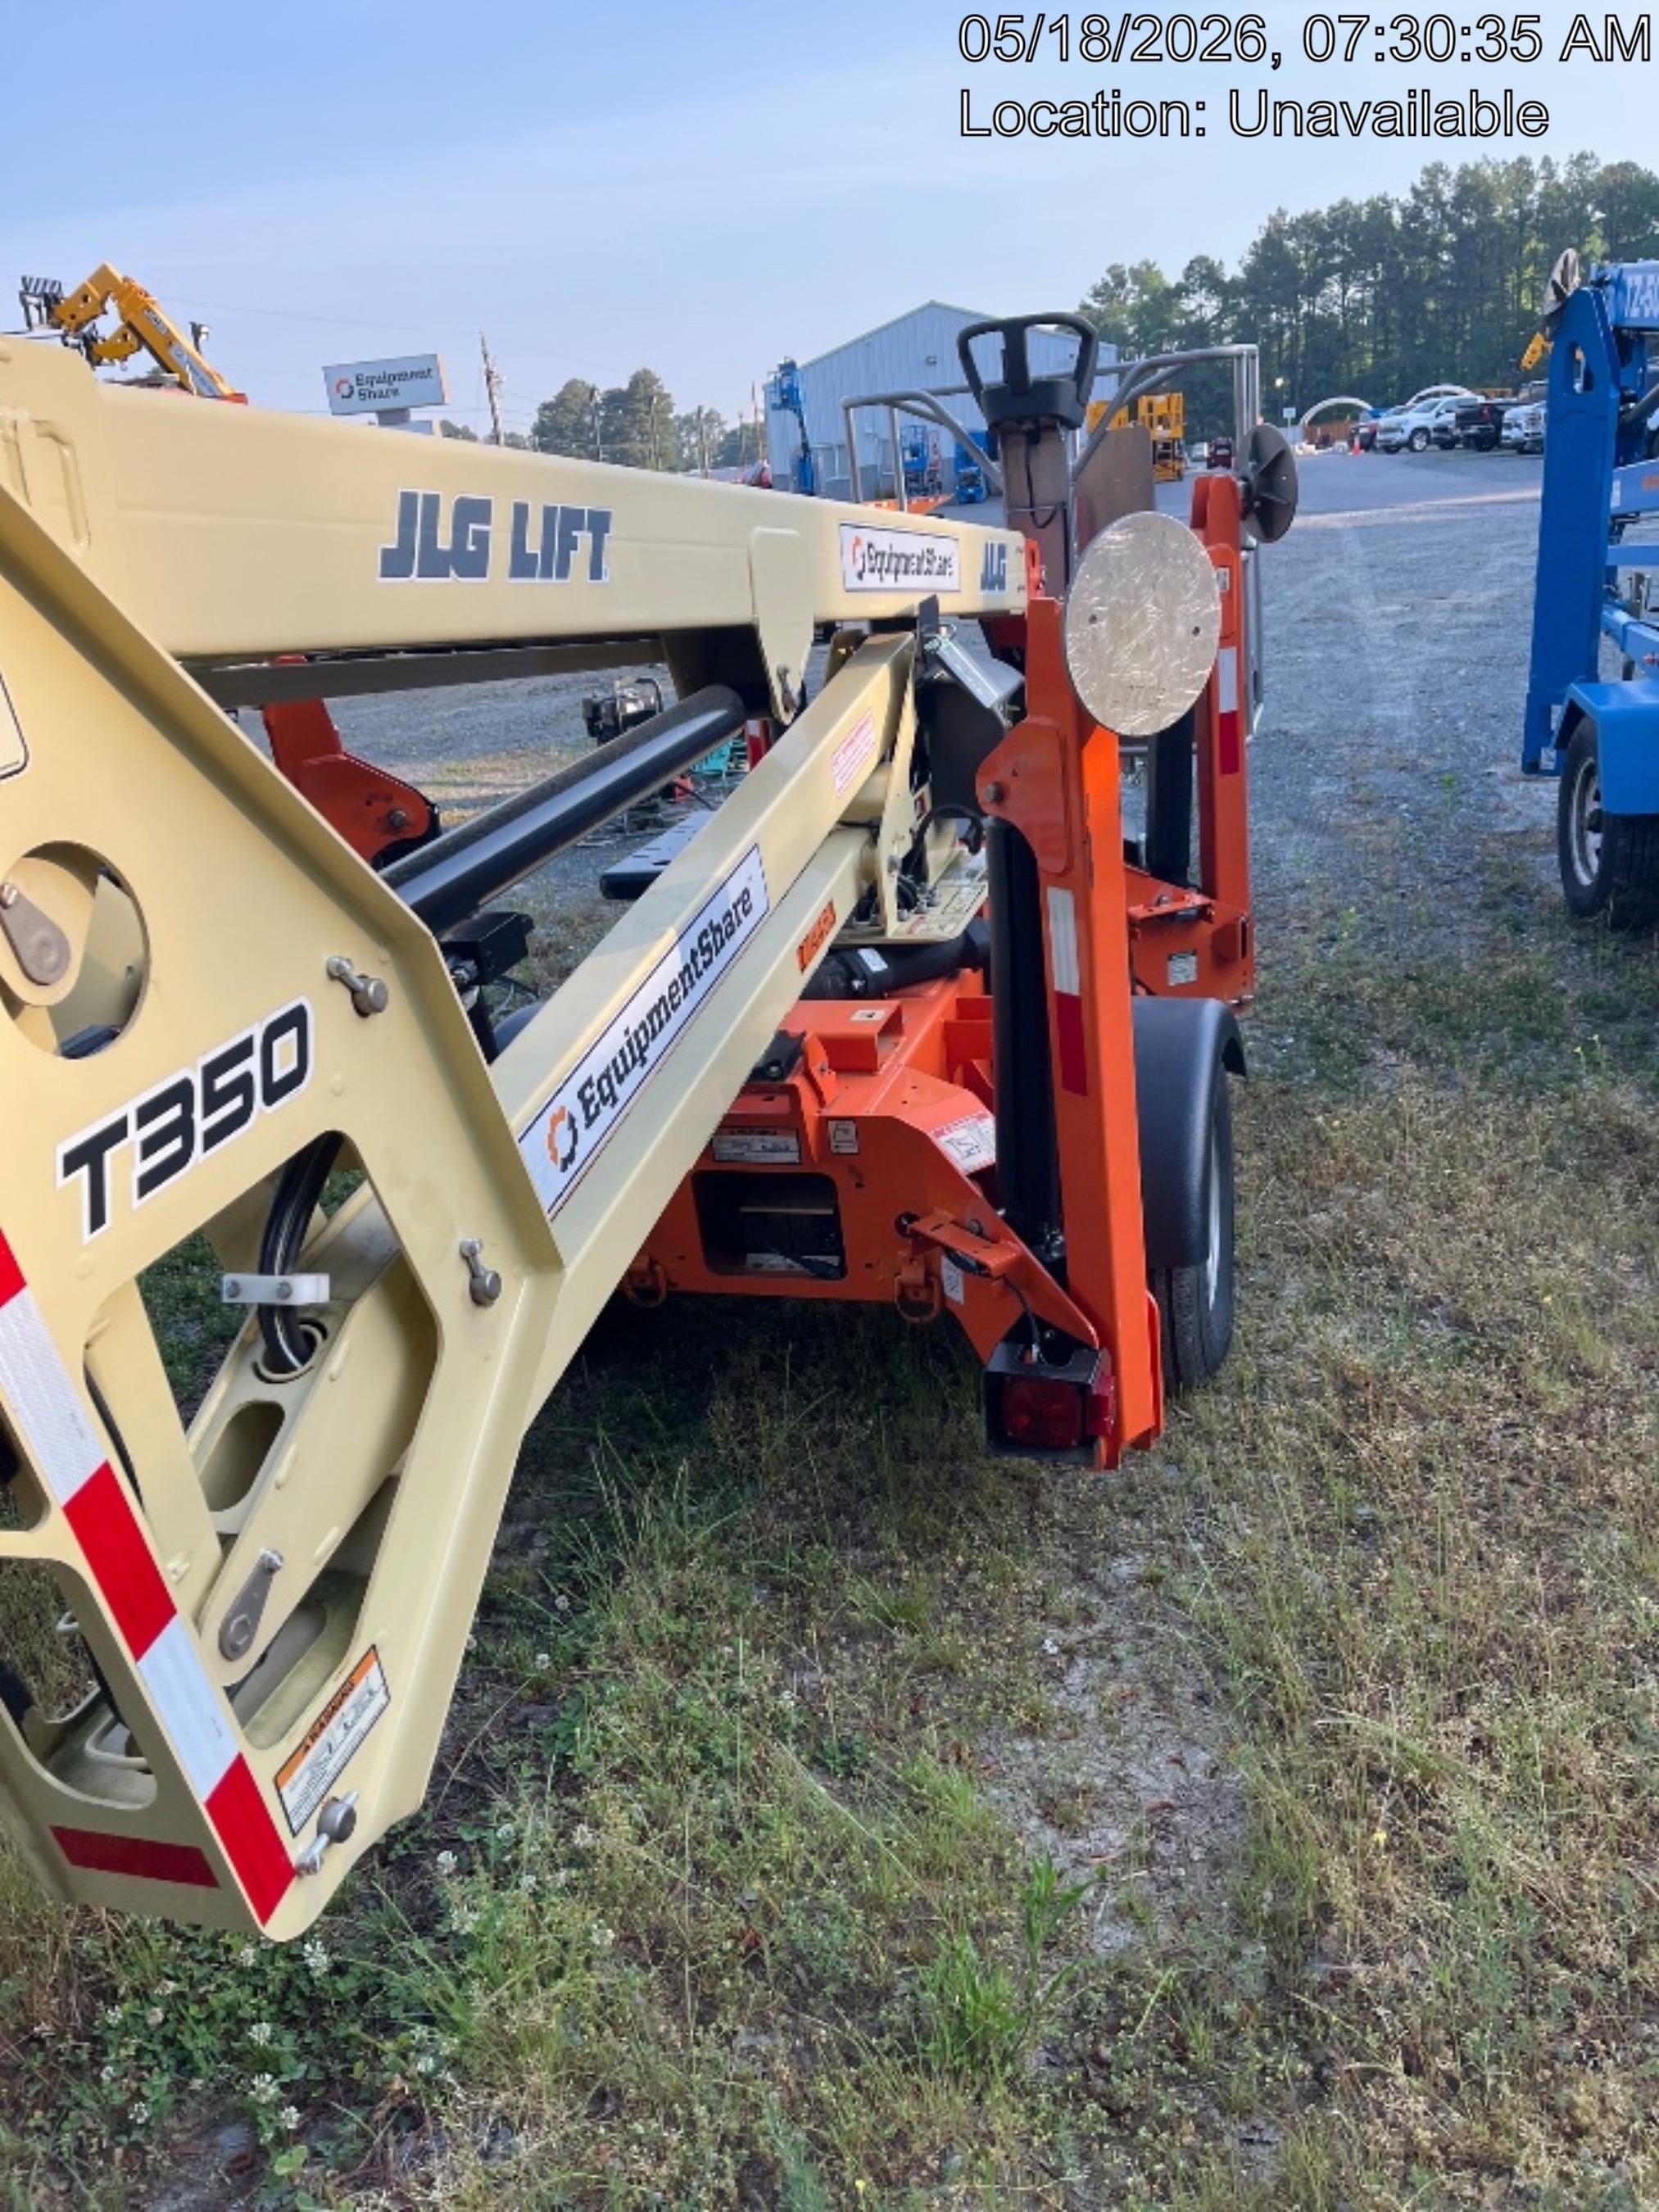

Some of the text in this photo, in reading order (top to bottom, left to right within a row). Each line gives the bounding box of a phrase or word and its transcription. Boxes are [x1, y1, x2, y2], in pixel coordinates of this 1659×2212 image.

[356, 367, 433, 387] Equipment
[358, 388, 399, 401] Share
[377, 489, 615, 583] JLG LIFT
[980, 541, 1008, 593] JLG
[576, 885, 753, 1130] EquipmentShare
[57, 997, 314, 1244] T350
